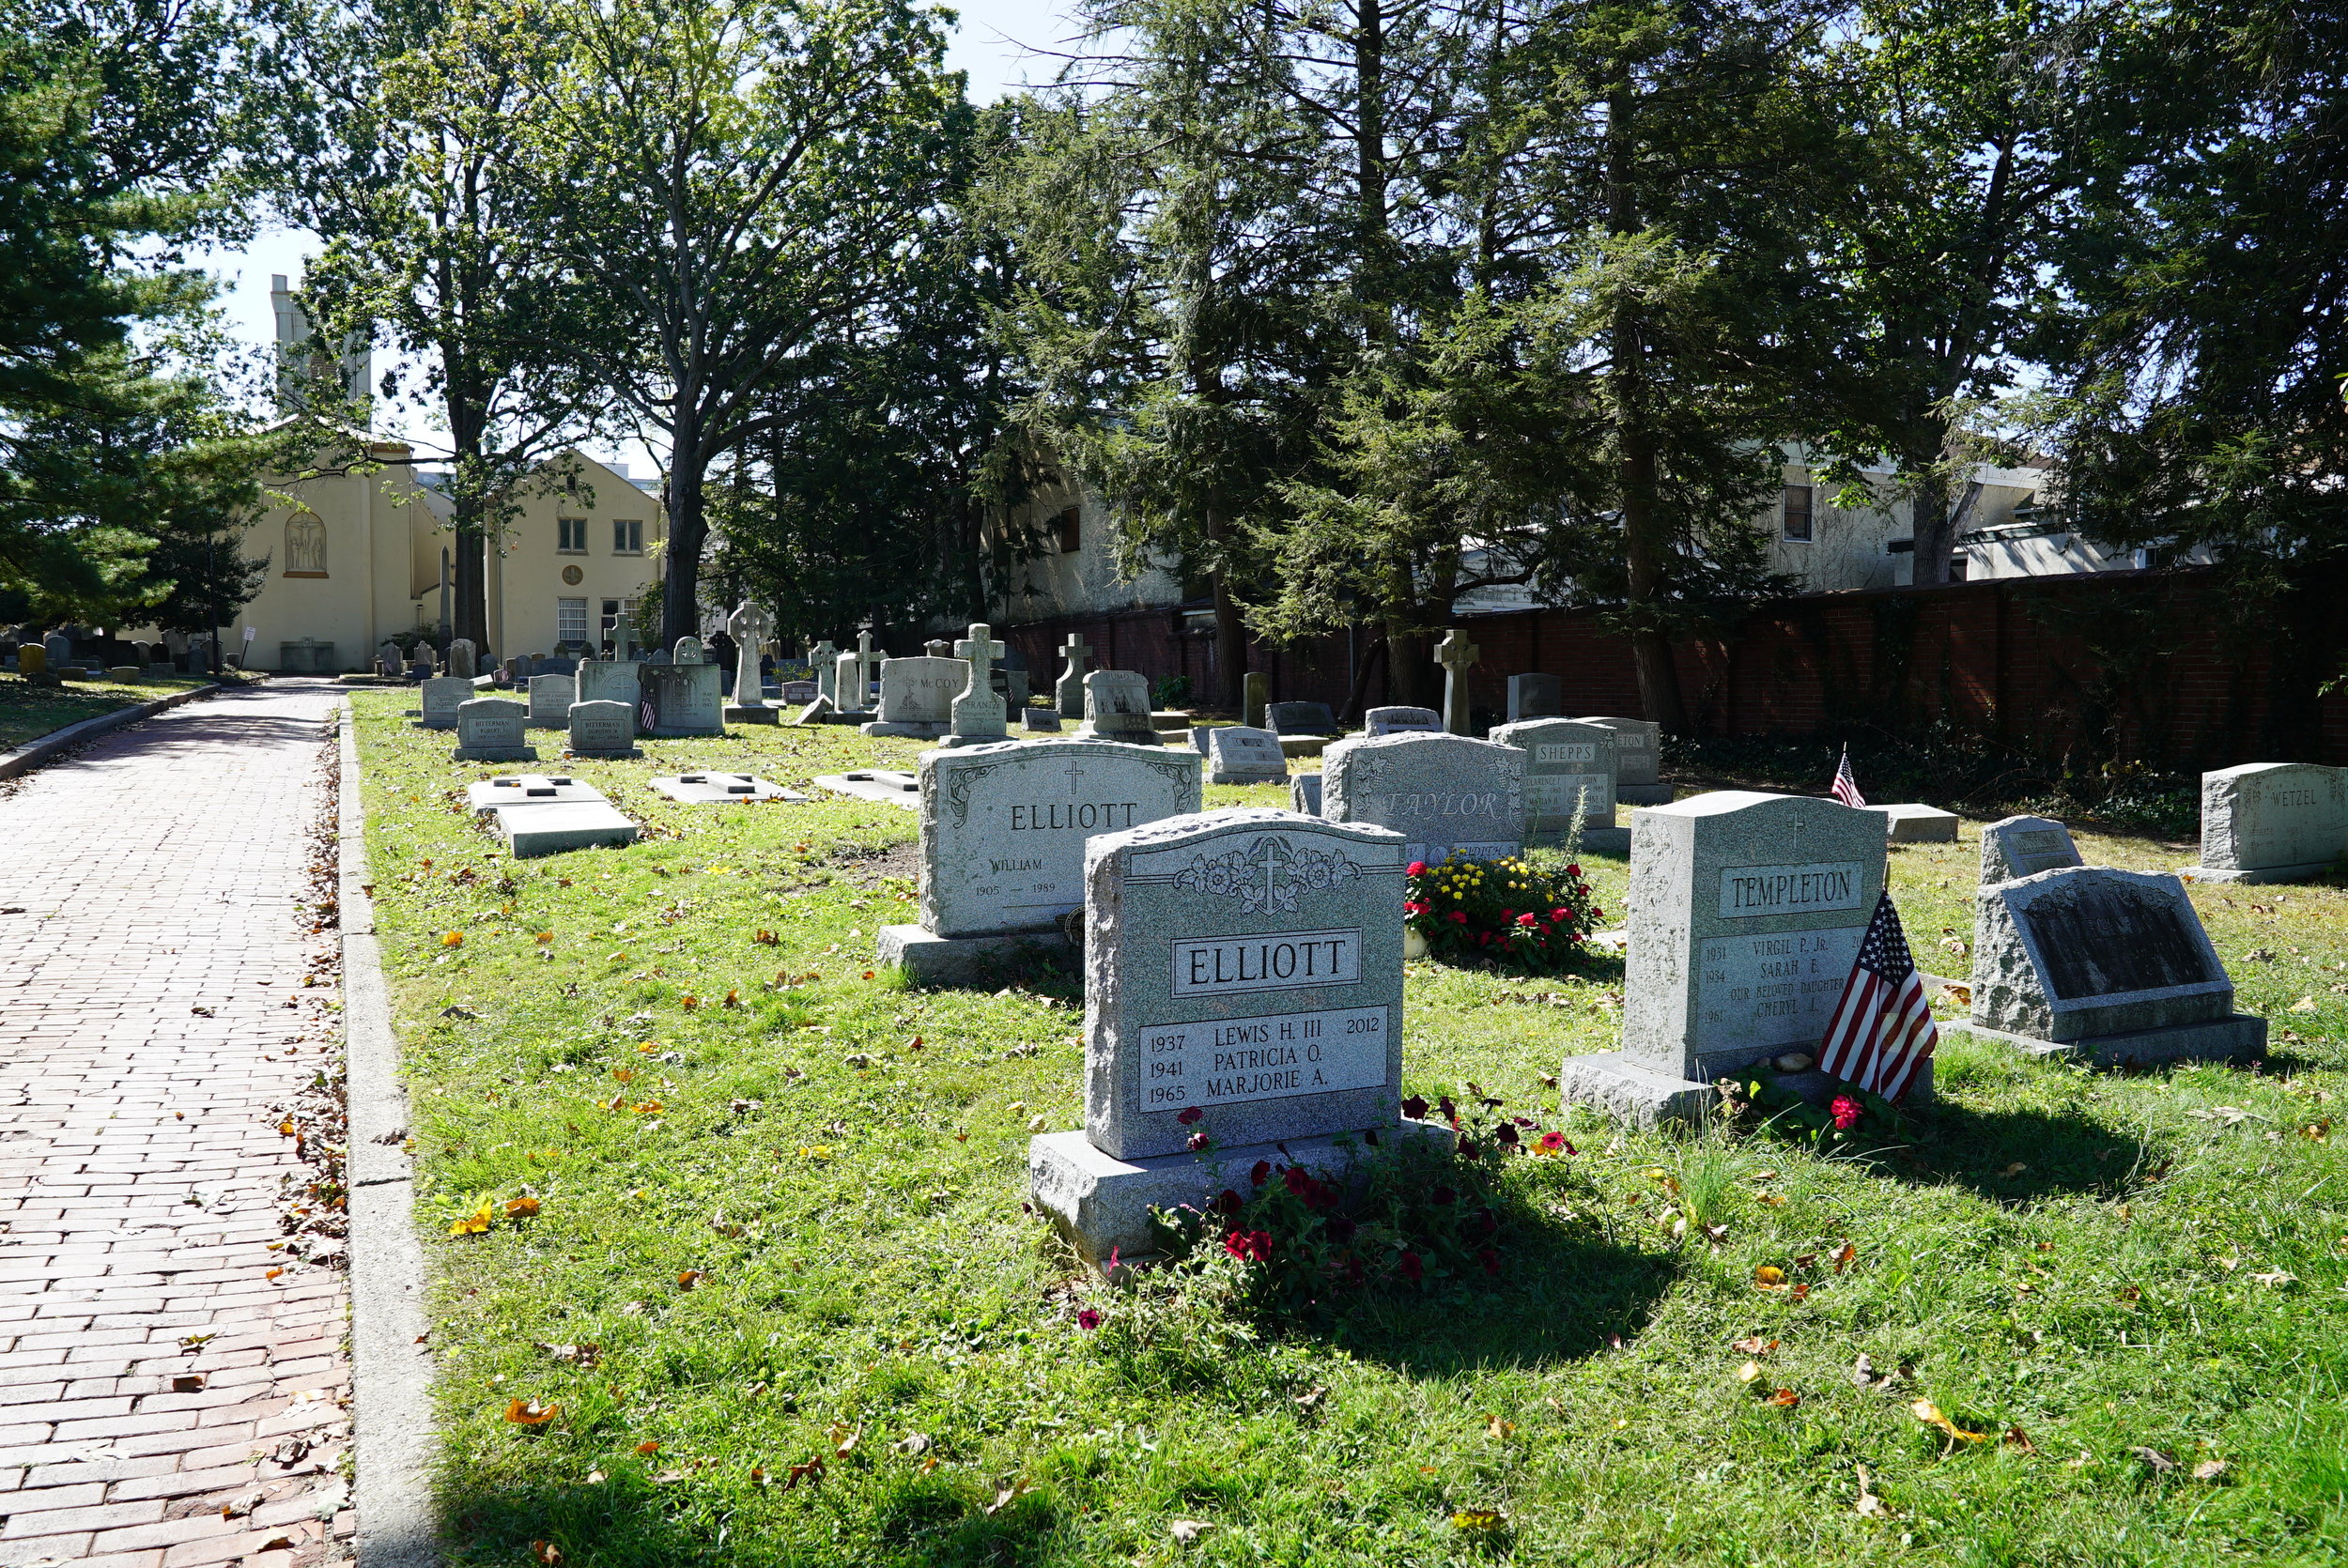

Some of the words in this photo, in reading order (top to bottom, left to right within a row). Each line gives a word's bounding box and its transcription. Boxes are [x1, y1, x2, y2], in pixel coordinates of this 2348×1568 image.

[920, 678, 960, 689] McCOY
[1539, 746, 1592, 760] SHEPPS
[1382, 792, 1502, 821] TAYLOR
[2272, 790, 2317, 807] WETZEL
[1011, 803, 1137, 831] ELLIOTT
[990, 858, 1043, 872] WILLIAM
[976, 885, 999, 897] 1905
[1032, 883, 1056, 893] 1989
[1732, 871, 1852, 908] TEMPLETON
[1189, 940, 1347, 985] ELLIOTT
[1706, 946, 1726, 961] 1931
[1753, 939, 1792, 957] VIRGIL
[1761, 960, 1800, 978] SARAH
[1730, 988, 1751, 1001] OUR
[1756, 983, 1794, 999] BELOVED
[1800, 977, 1845, 994] DAUGHTER
[1704, 1010, 1724, 1025] 1961
[1756, 999, 1799, 1019] CHERYL
[1151, 1035, 1186, 1053] 1937
[1214, 1024, 1269, 1047] LEWIS
[1279, 1022, 1296, 1040] H.
[1304, 1020, 1322, 1038] III
[1347, 1017, 1380, 1034] 2012
[1150, 1061, 1183, 1078] 1941
[1214, 1047, 1298, 1072] PATRICIA
[1307, 1044, 1323, 1062] O.
[1150, 1086, 1186, 1103] 1965
[1207, 1070, 1301, 1098] MARJORIE
[1310, 1068, 1329, 1085] A.
